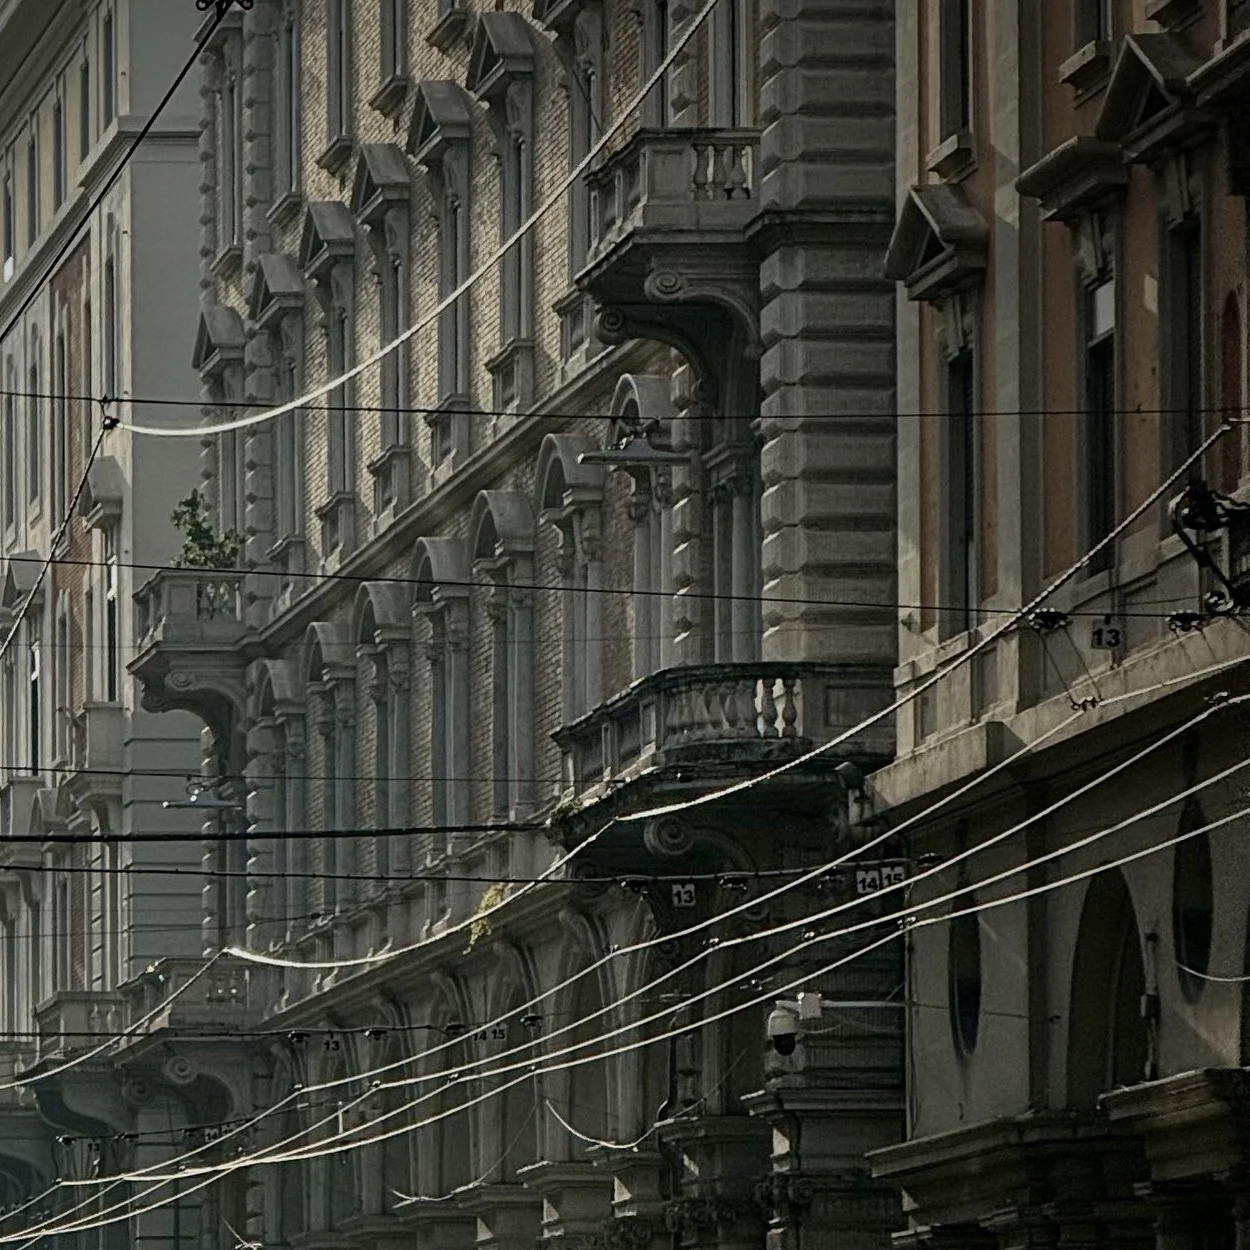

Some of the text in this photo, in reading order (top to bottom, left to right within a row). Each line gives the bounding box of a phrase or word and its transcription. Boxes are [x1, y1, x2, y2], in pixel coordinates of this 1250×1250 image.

[1092, 629, 1120, 647] 13
[859, 873, 904, 891] 14 15
[674, 891, 694, 904] 13
[491, 1029, 506, 1040] 15
[324, 1040, 340, 1051] 13
